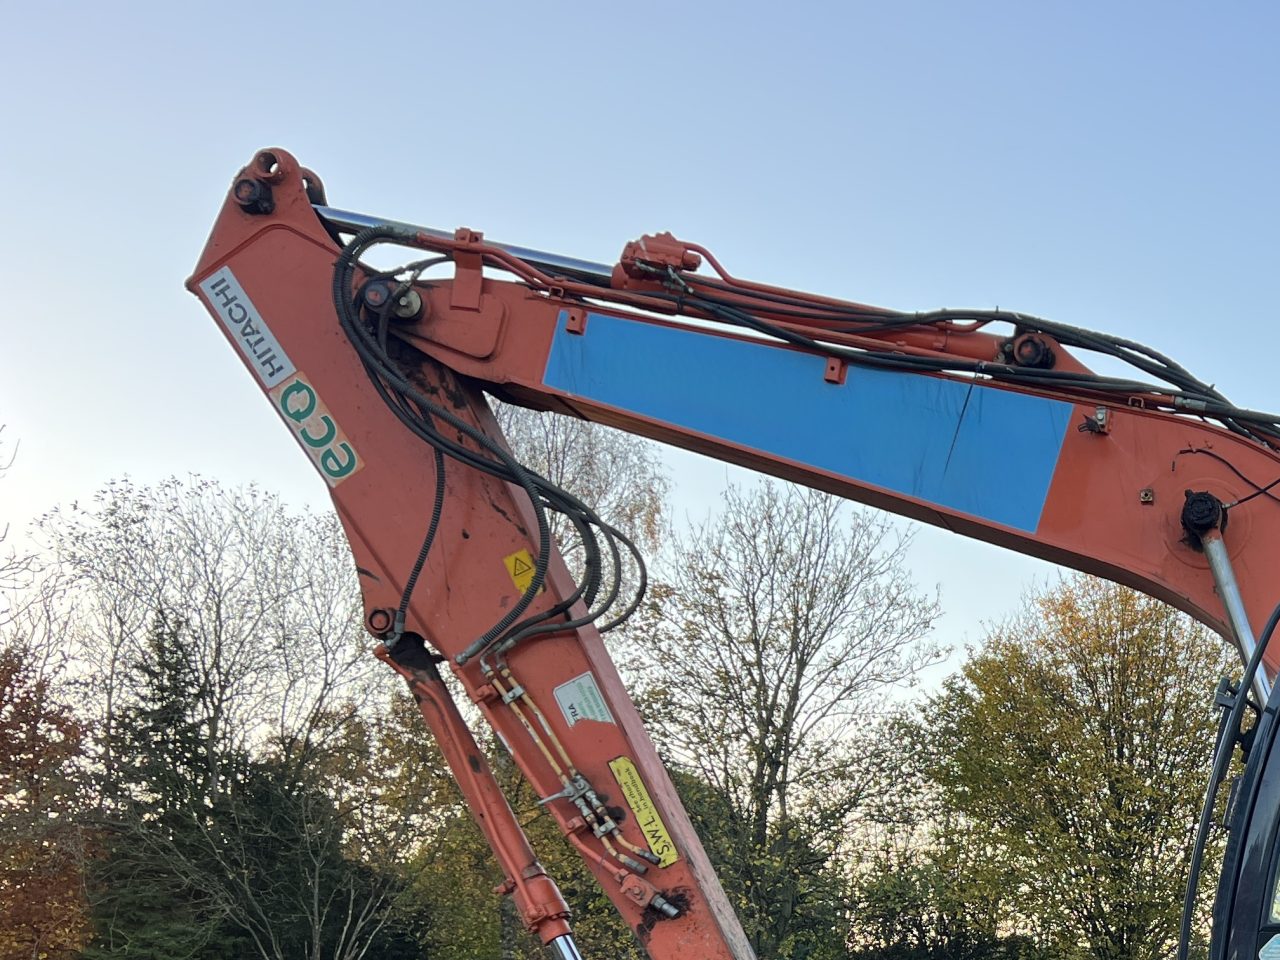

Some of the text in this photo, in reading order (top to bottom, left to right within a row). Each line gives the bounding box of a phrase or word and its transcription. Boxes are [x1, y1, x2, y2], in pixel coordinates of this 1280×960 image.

[210, 277, 284, 378] HITACHI
[280, 378, 356, 479] eco
[625, 767, 645, 802] handbook
